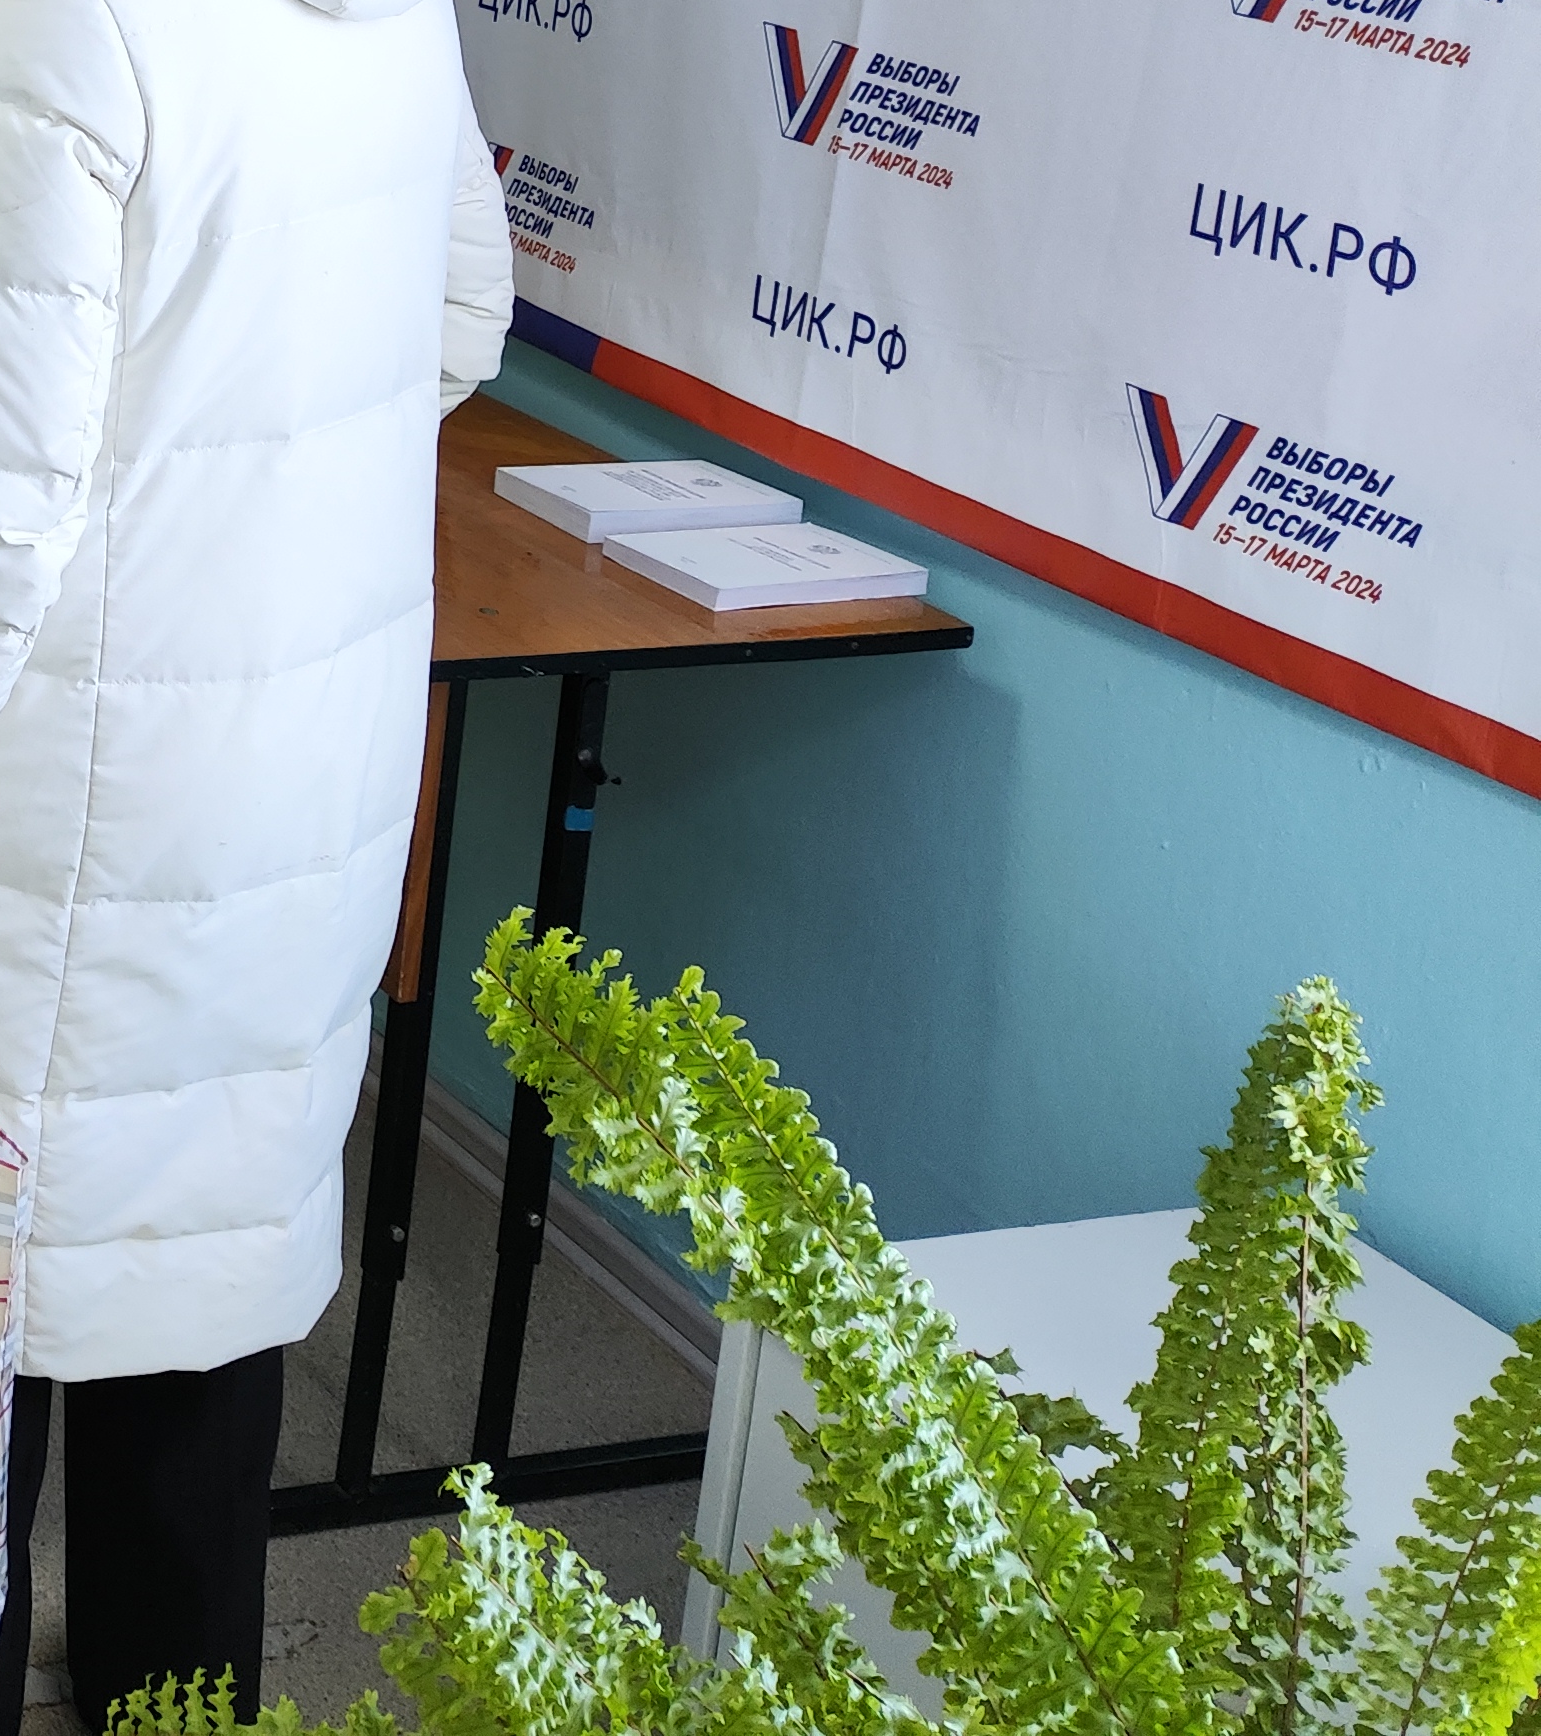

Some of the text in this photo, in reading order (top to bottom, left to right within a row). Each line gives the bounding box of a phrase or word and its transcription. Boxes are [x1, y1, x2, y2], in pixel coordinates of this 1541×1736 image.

[1345, 20, 1416, 57] МАРТА
[1414, 36, 1472, 69] 2024
[865, 53, 960, 98] ВЫБОРЫ
[837, 109, 923, 151] РОССИИ
[849, 81, 981, 138] ПРЕЗИДЕНТА
[518, 154, 579, 194] ВЫБОРЫ
[866, 146, 920, 179] МАРТА
[916, 163, 954, 190] 2024
[507, 178, 595, 229] ПРЕЗИДЕНТА
[515, 235, 552, 263] МАРТА
[550, 250, 576, 274] 2024
[1189, 183, 1418, 297] ЦИК.РФ
[751, 274, 907, 375] ЦИК.РФ
[1266, 436, 1396, 498] ВЫБОРЫ
[1228, 495, 1341, 554] РОССИИ
[1247, 465, 1424, 550] ПРЕЗИДЕНТА
[1262, 538, 1330, 584] МАРТА
[1331, 566, 1384, 606] 2024
